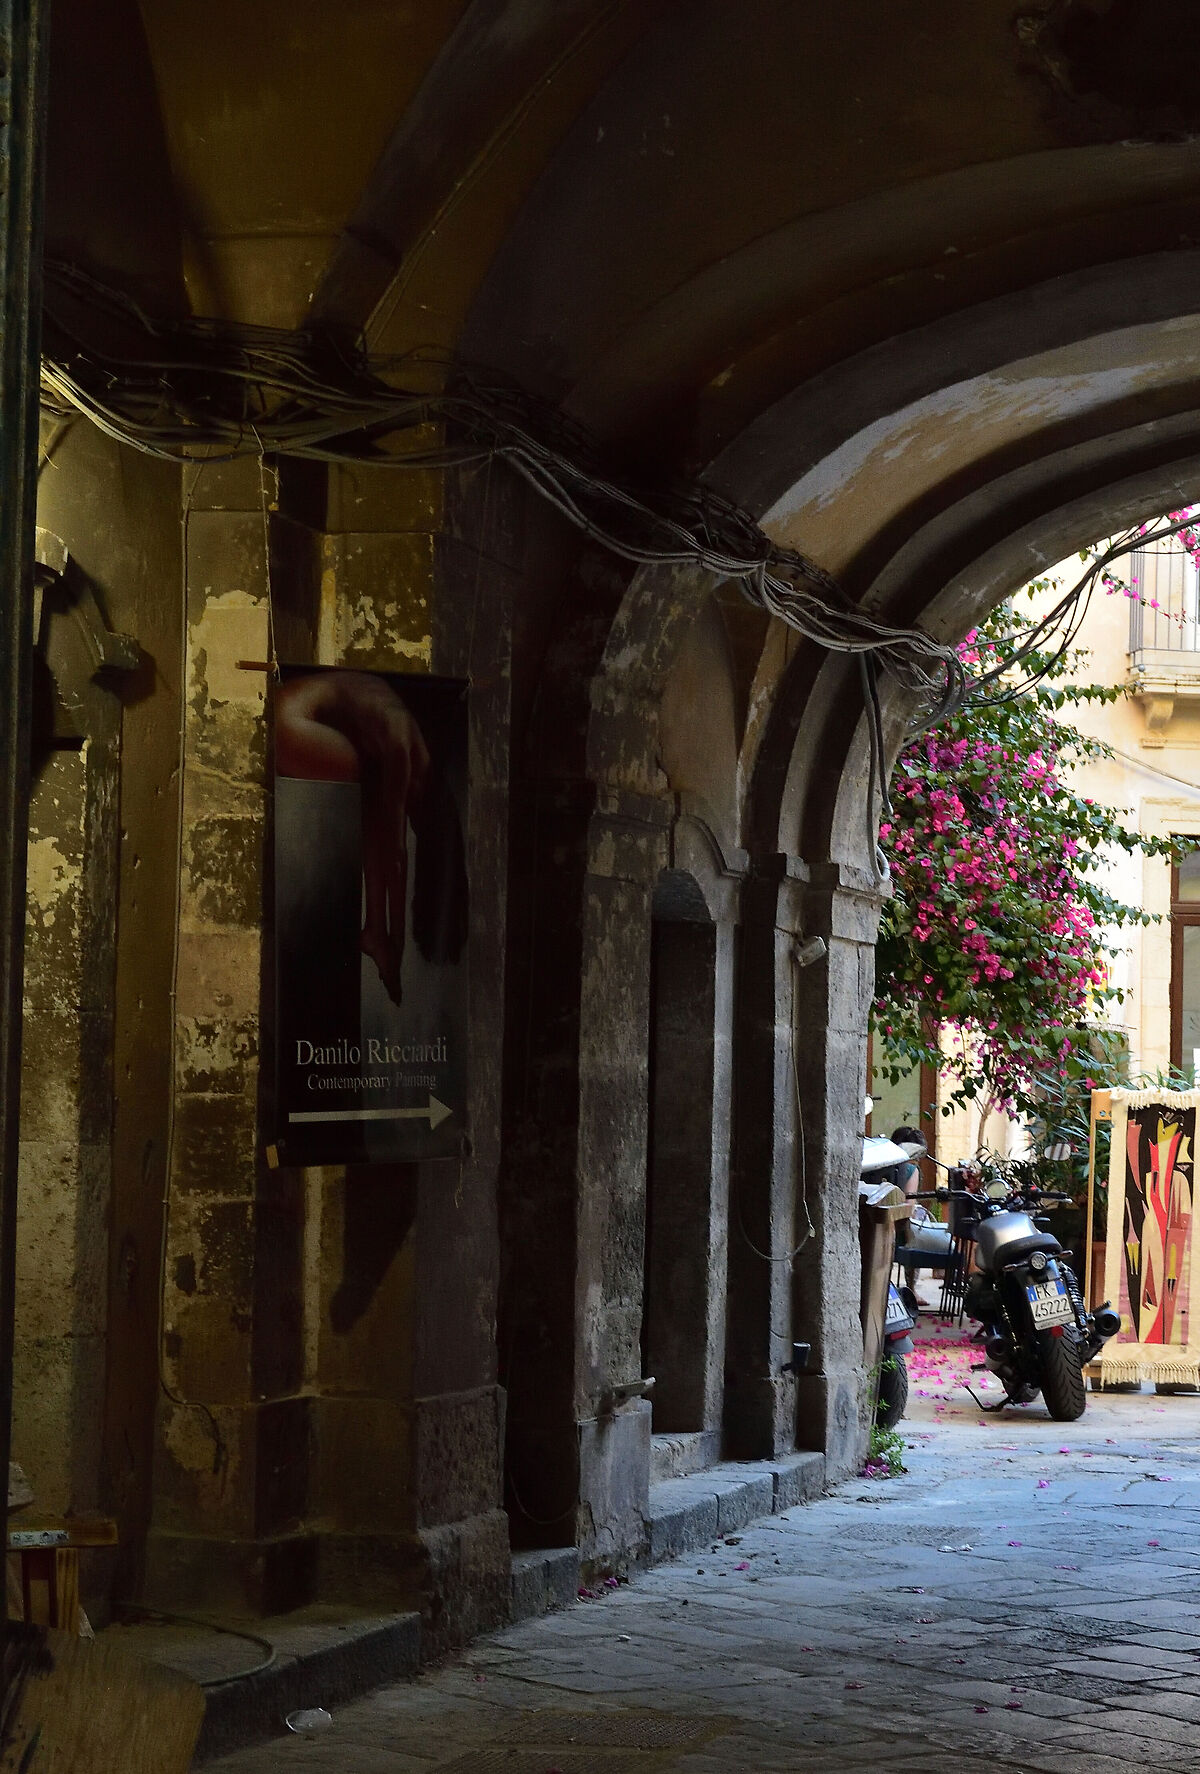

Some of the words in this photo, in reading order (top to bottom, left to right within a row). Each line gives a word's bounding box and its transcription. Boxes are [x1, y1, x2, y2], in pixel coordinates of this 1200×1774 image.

[296, 1038, 361, 1065] Danilo
[367, 1036, 448, 1064] Ricciardi
[307, 1073, 391, 1094] Contemporary
[395, 1070, 437, 1090] Painting
[1035, 1283, 1051, 1300] FK
[887, 1301, 905, 1319] 271
[1035, 1297, 1070, 1318] 45222
